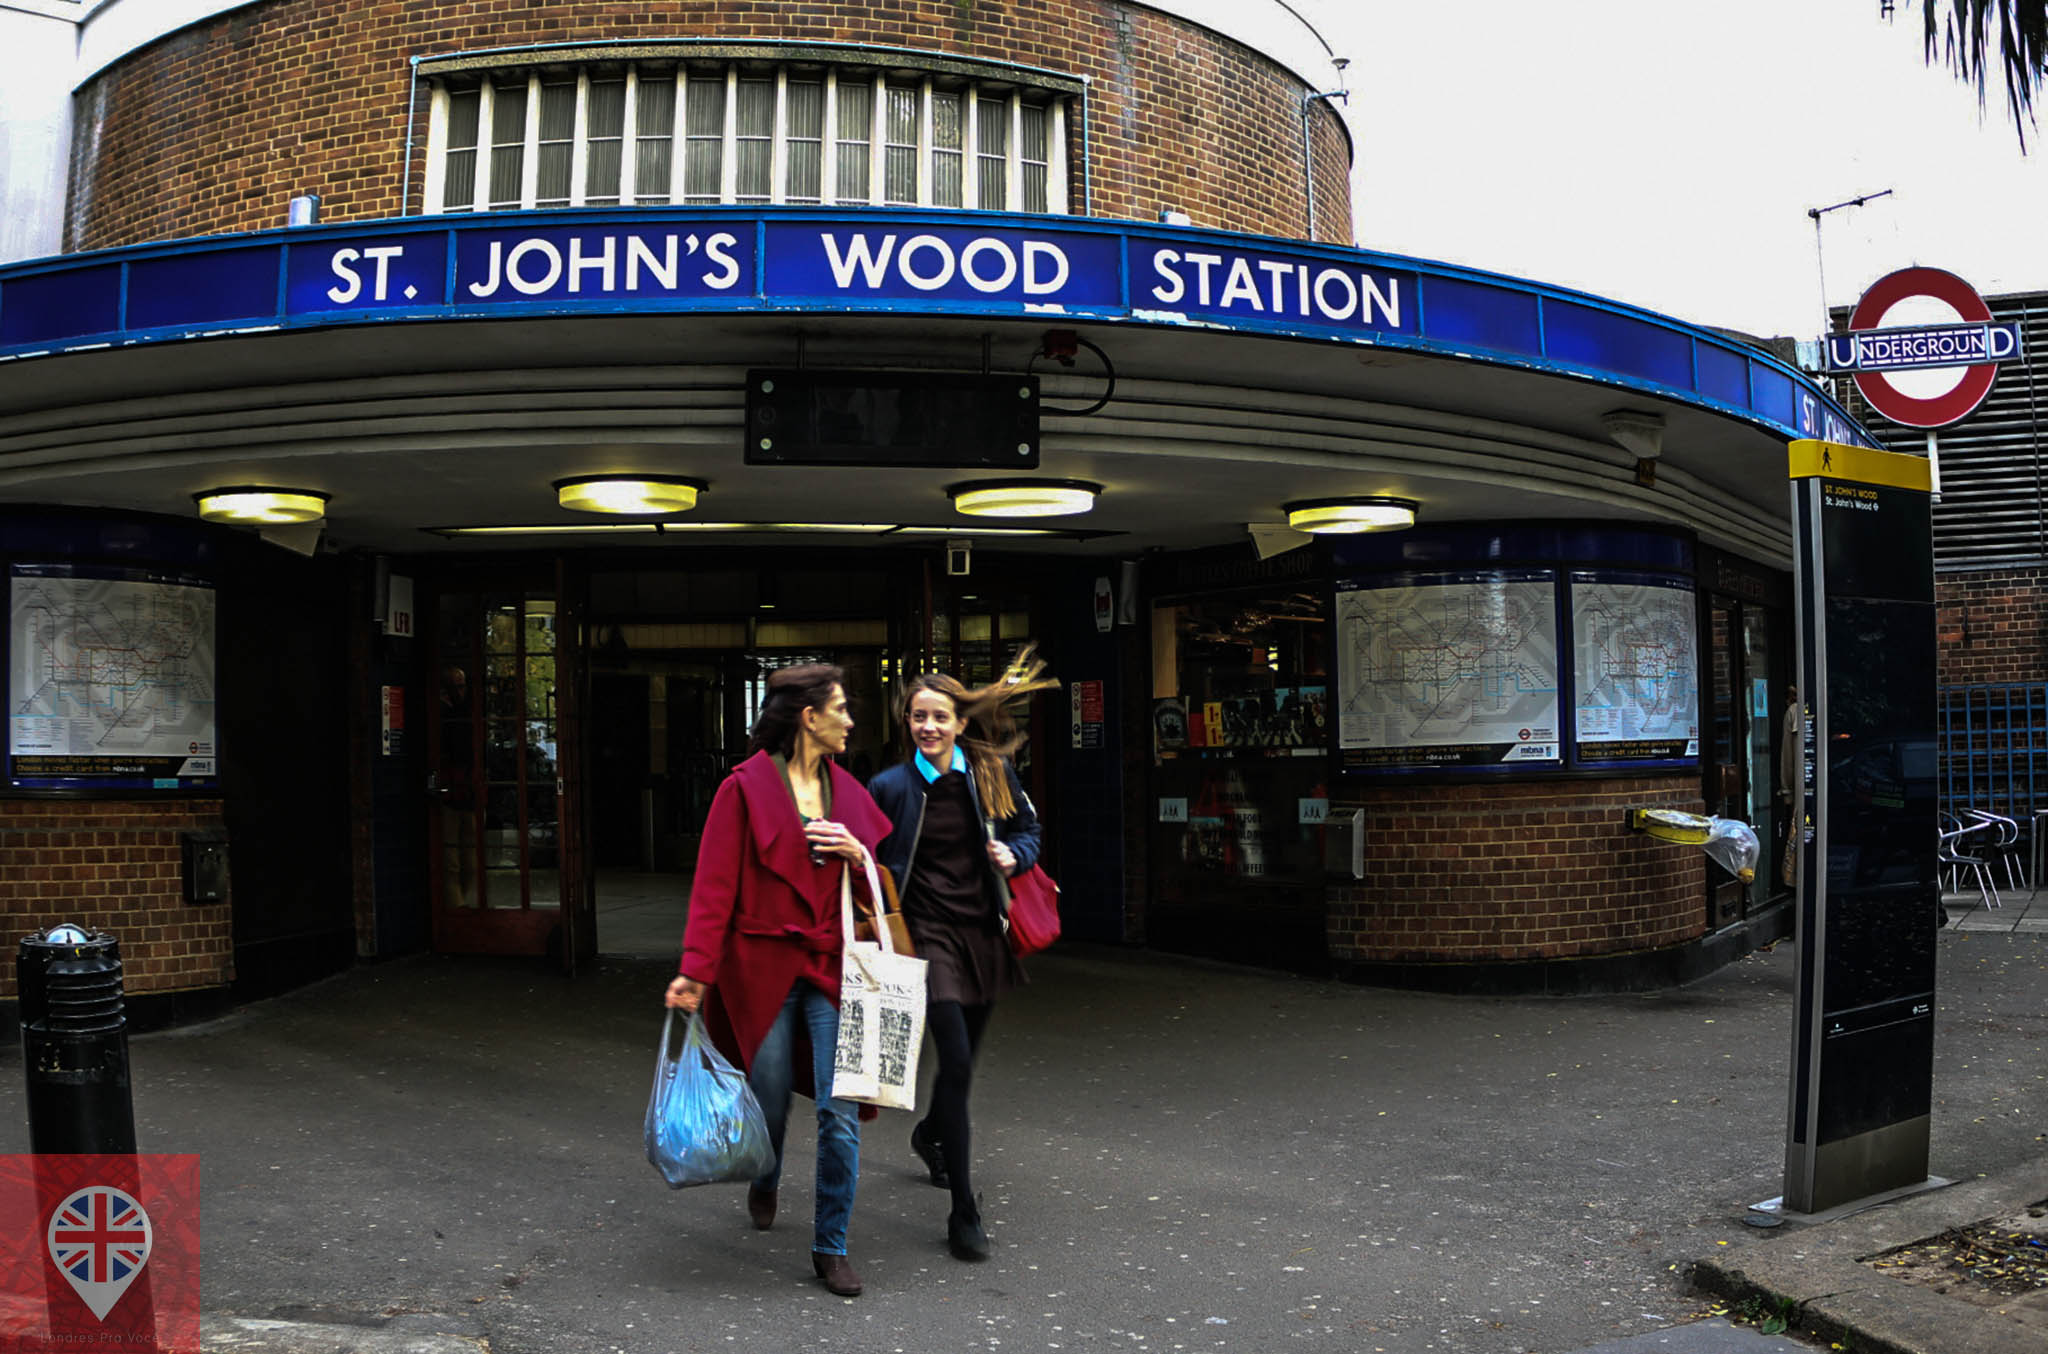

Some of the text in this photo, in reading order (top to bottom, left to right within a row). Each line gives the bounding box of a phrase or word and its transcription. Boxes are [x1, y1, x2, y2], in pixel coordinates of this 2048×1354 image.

[327, 232, 1401, 328] ST. JOHN'S WOOD STATION
[1831, 327, 2015, 368] UNDERGROUND
